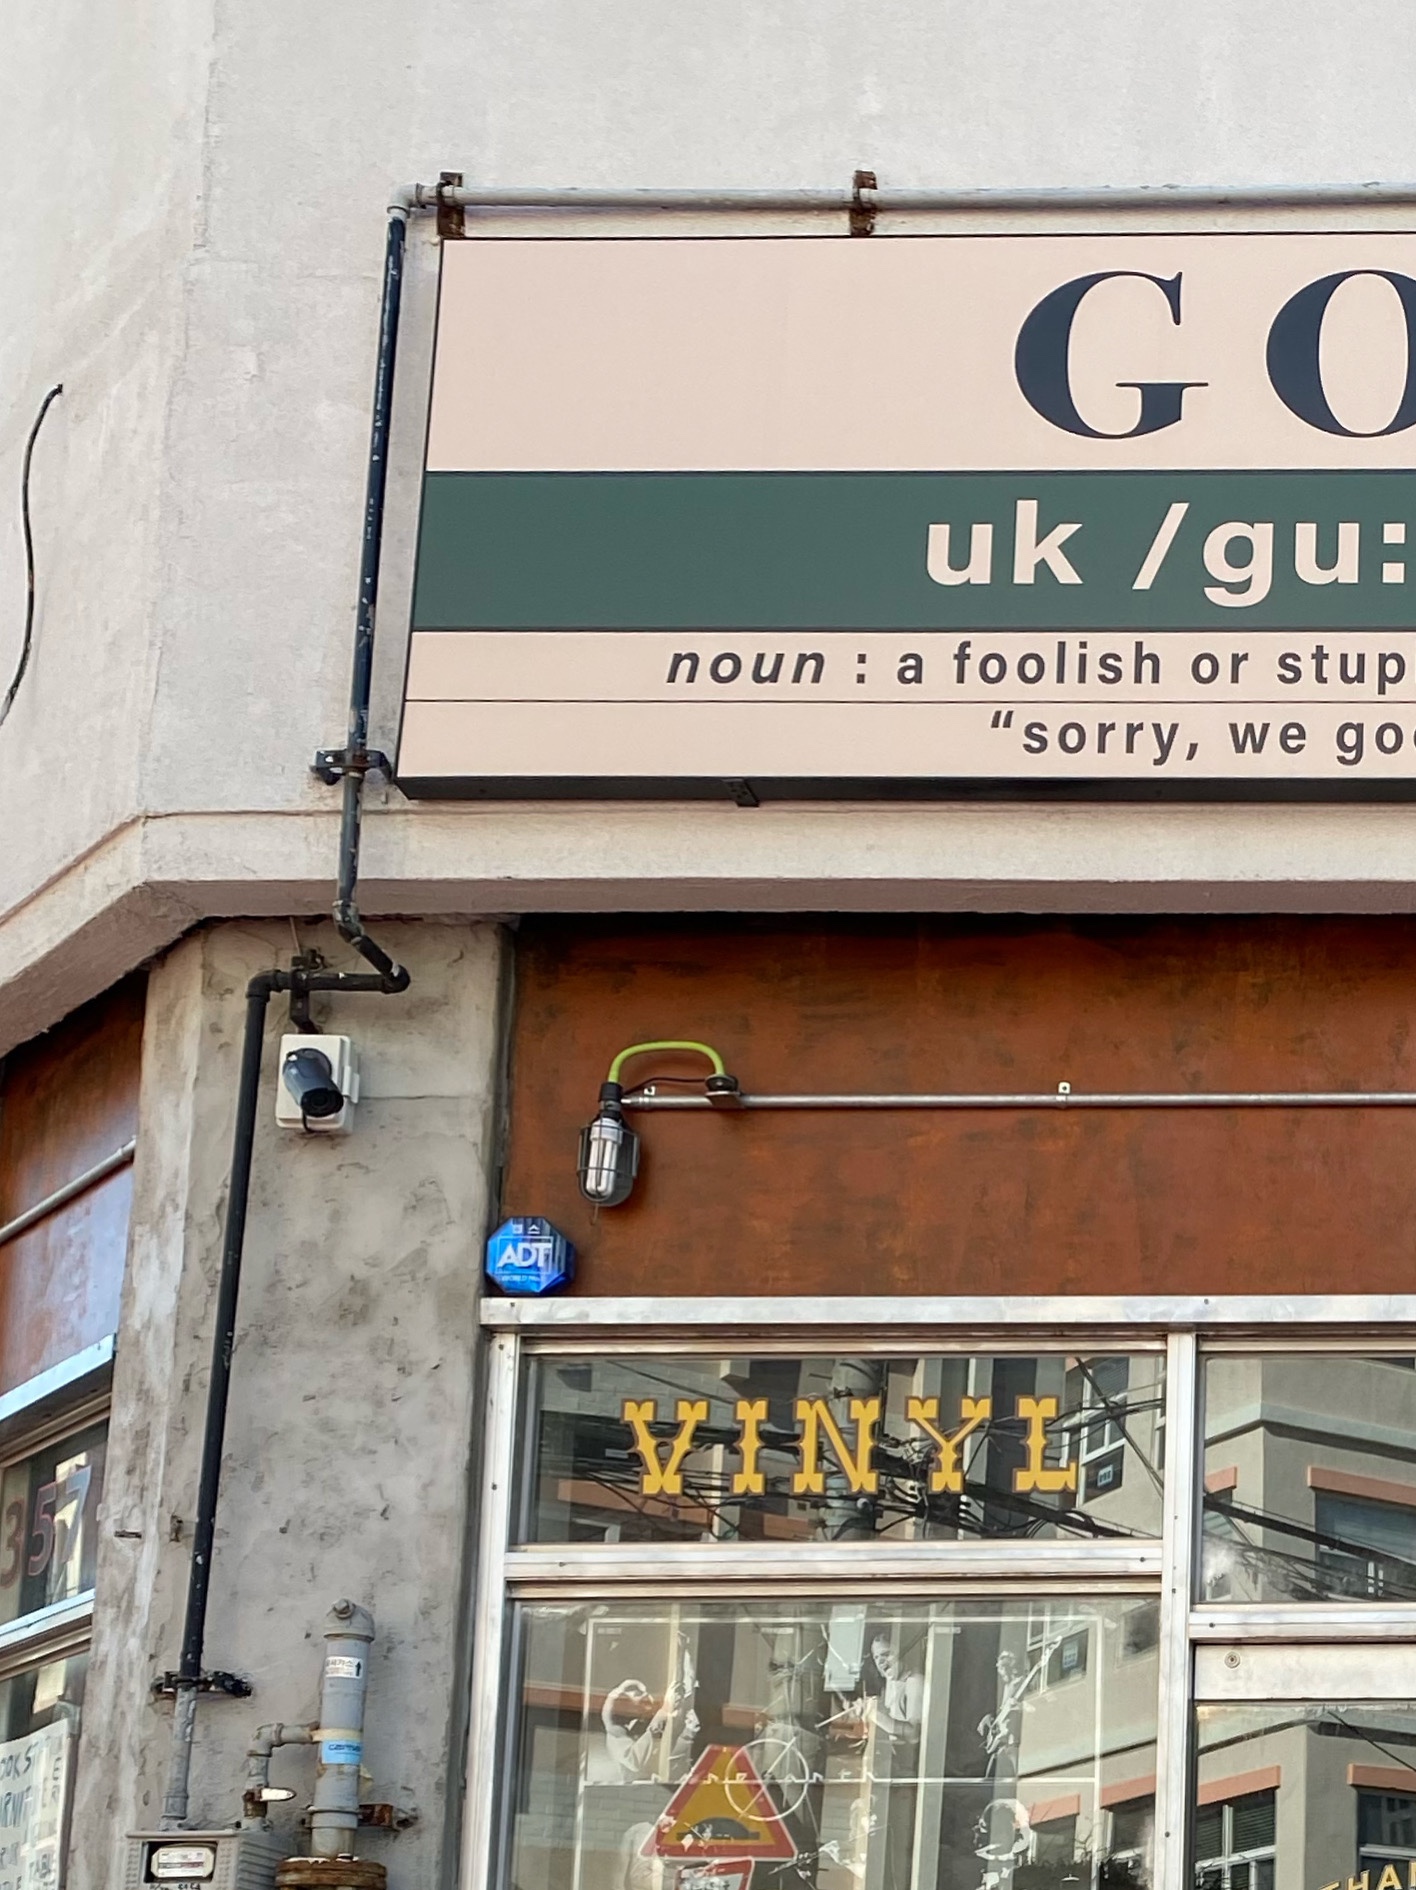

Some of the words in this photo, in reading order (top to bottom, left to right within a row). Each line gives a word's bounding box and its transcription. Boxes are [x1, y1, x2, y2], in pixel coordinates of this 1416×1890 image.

[927, 500, 1084, 586] uk
[666, 652, 826, 685] noun
[897, 652, 924, 685] a
[953, 640, 1161, 685] foolish
[1191, 652, 1249, 685] or
[990, 710, 1199, 766] “sorry,
[1228, 721, 1307, 754] we
[496, 1242, 553, 1268] ADT
[621, 1396, 1079, 1497] VINYL
